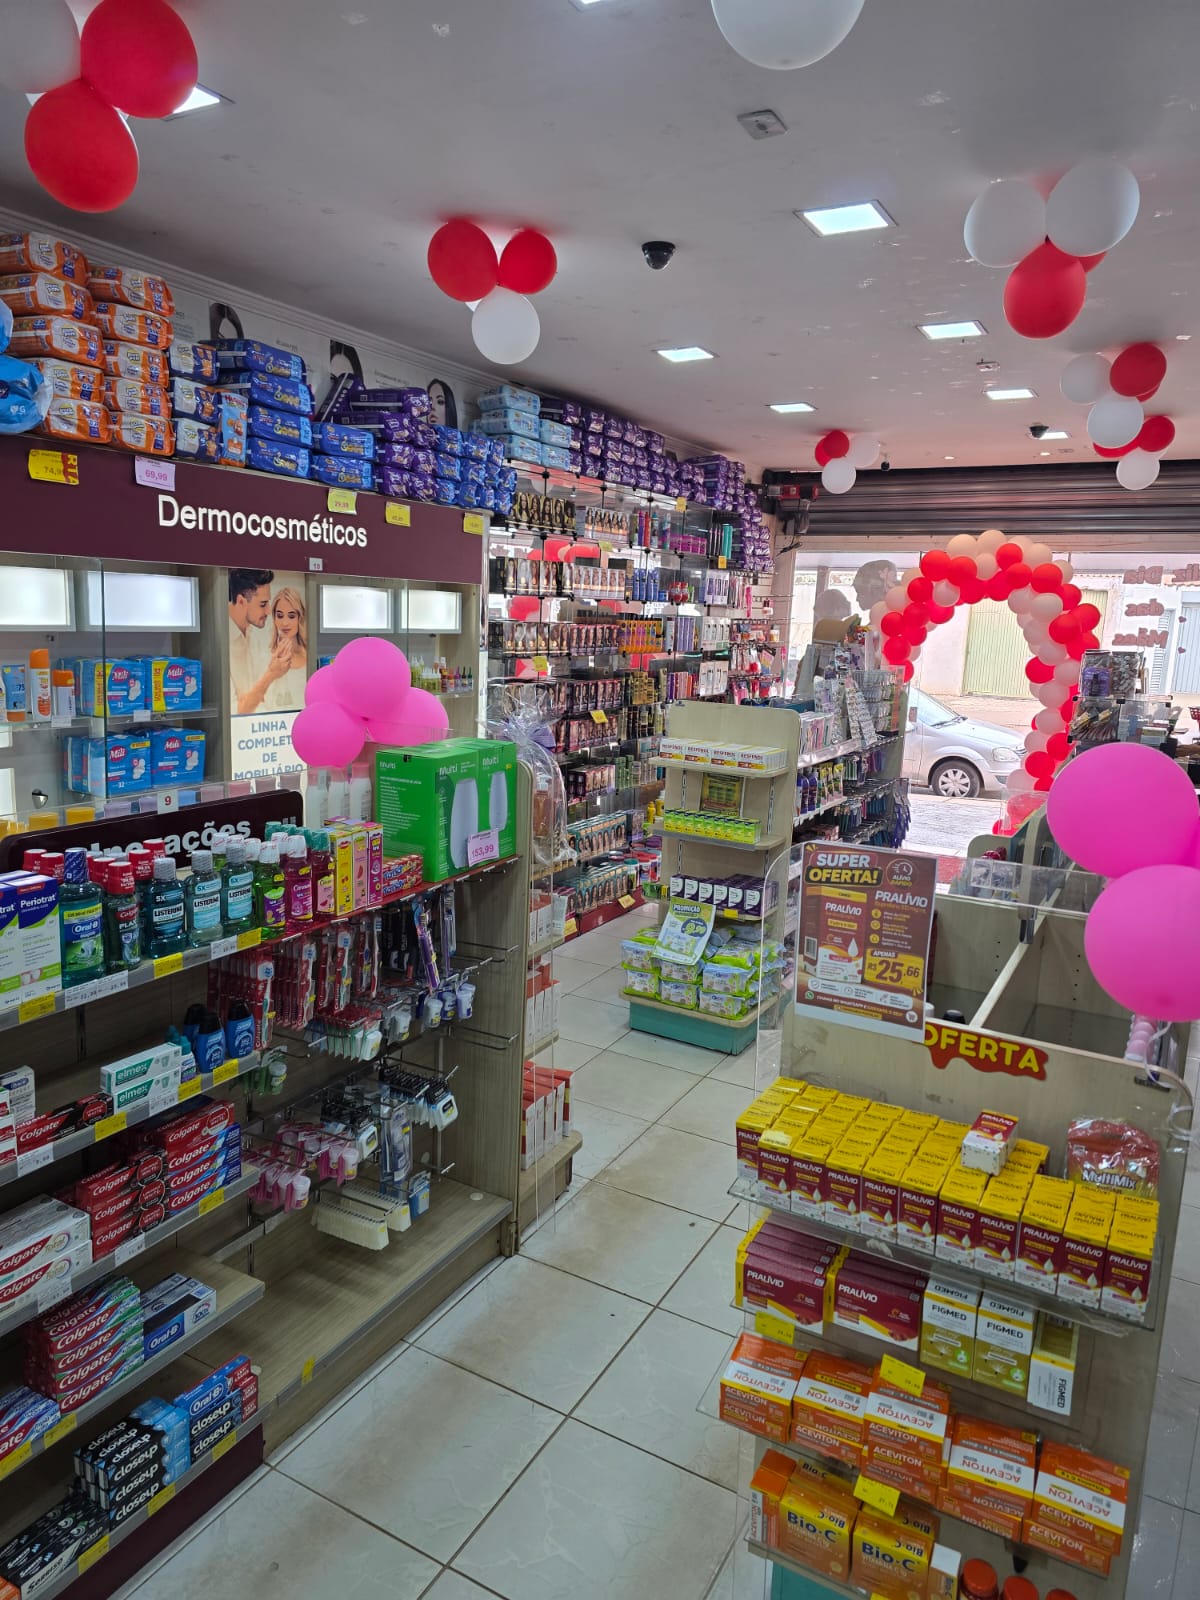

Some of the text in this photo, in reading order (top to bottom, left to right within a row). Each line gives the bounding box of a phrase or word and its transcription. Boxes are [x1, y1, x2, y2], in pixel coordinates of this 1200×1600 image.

[145, 469, 168, 481] 69,99
[157, 493, 369, 548] Dermocosméticos
[251, 719, 287, 734] LINHA
[237, 734, 293, 751] COMPLET
[262, 752, 277, 763] DE
[439, 763, 458, 776] Multi
[164, 796, 172, 806] 9
[471, 844, 494, 858] 153,99
[816, 853, 870, 868] SUPER
[809, 868, 878, 884] OFERTA!
[20, 893, 57, 909] Periotrat
[825, 902, 862, 917] PRALÍVIO
[874, 890, 928, 908] PRALÍVIO
[924, 1023, 1040, 1073] OFERTA
[117, 1063, 147, 1080] elmex
[119, 1085, 147, 1102] elmex
[20, 1120, 59, 1142] Colgate
[168, 1121, 201, 1143] Colgate
[738, 1130, 761, 1142] PRALÍV
[168, 1143, 210, 1169] Colgate
[760, 1151, 789, 1164] PRALÍVIO
[169, 1161, 210, 1188] Colgate
[792, 1160, 822, 1174] PRALÍVIO
[93, 1173, 130, 1197] Colgate
[827, 1171, 858, 1185] PRALÍVIO
[864, 1181, 896, 1196] PRALÍVIO
[1082, 1168, 1137, 1190] MultiMix
[171, 1181, 212, 1208] Colgate
[902, 1191, 935, 1206] PRALÍVIO
[94, 1196, 133, 1221] Colgate
[941, 1203, 975, 1220] PRALÍVIO
[96, 1221, 133, 1246] Colgate
[979, 1216, 1015, 1232] PRALÍVIO
[1023, 1227, 1060, 1244] PRALÍVIO
[1065, 1241, 1104, 1258] PRALÍVIO
[1109, 1254, 1148, 1272] PRALÍVIO
[747, 1269, 784, 1289] PRALÍVIO
[838, 1283, 878, 1303] PRALÍVIO
[48, 1304, 97, 1336] Colgate
[931, 1303, 967, 1322] FIGMED
[56, 1311, 110, 1350] Colgate
[149, 1324, 179, 1350] Oral-B
[986, 1320, 1024, 1340] FIGMED
[57, 1330, 112, 1369] Colgate
[58, 1350, 114, 1389] Colgate
[60, 1371, 114, 1410] Colgate
[734, 1373, 784, 1394] ACEVITON
[1056, 1377, 1067, 1409] FIGMED
[192, 1385, 222, 1413] Oral-B
[806, 1389, 859, 1412] ACEVITON
[191, 1401, 231, 1435] closeup
[877, 1405, 934, 1430] ACEVITON
[193, 1420, 232, 1455] closeup
[795, 1424, 840, 1446] ACEVITON
[869, 1423, 918, 1443] ACEVITON
[114, 1445, 158, 1481] closeup
[873, 1446, 922, 1467] ACEVITON
[962, 1459, 1021, 1483] ACEVITON
[116, 1463, 159, 1502] closeup
[116, 1482, 160, 1521] closeup
[1048, 1487, 1111, 1518] ACEVITON
[1040, 1504, 1094, 1531] ACEVITON
[1030, 1525, 1083, 1552] ACEVITON
